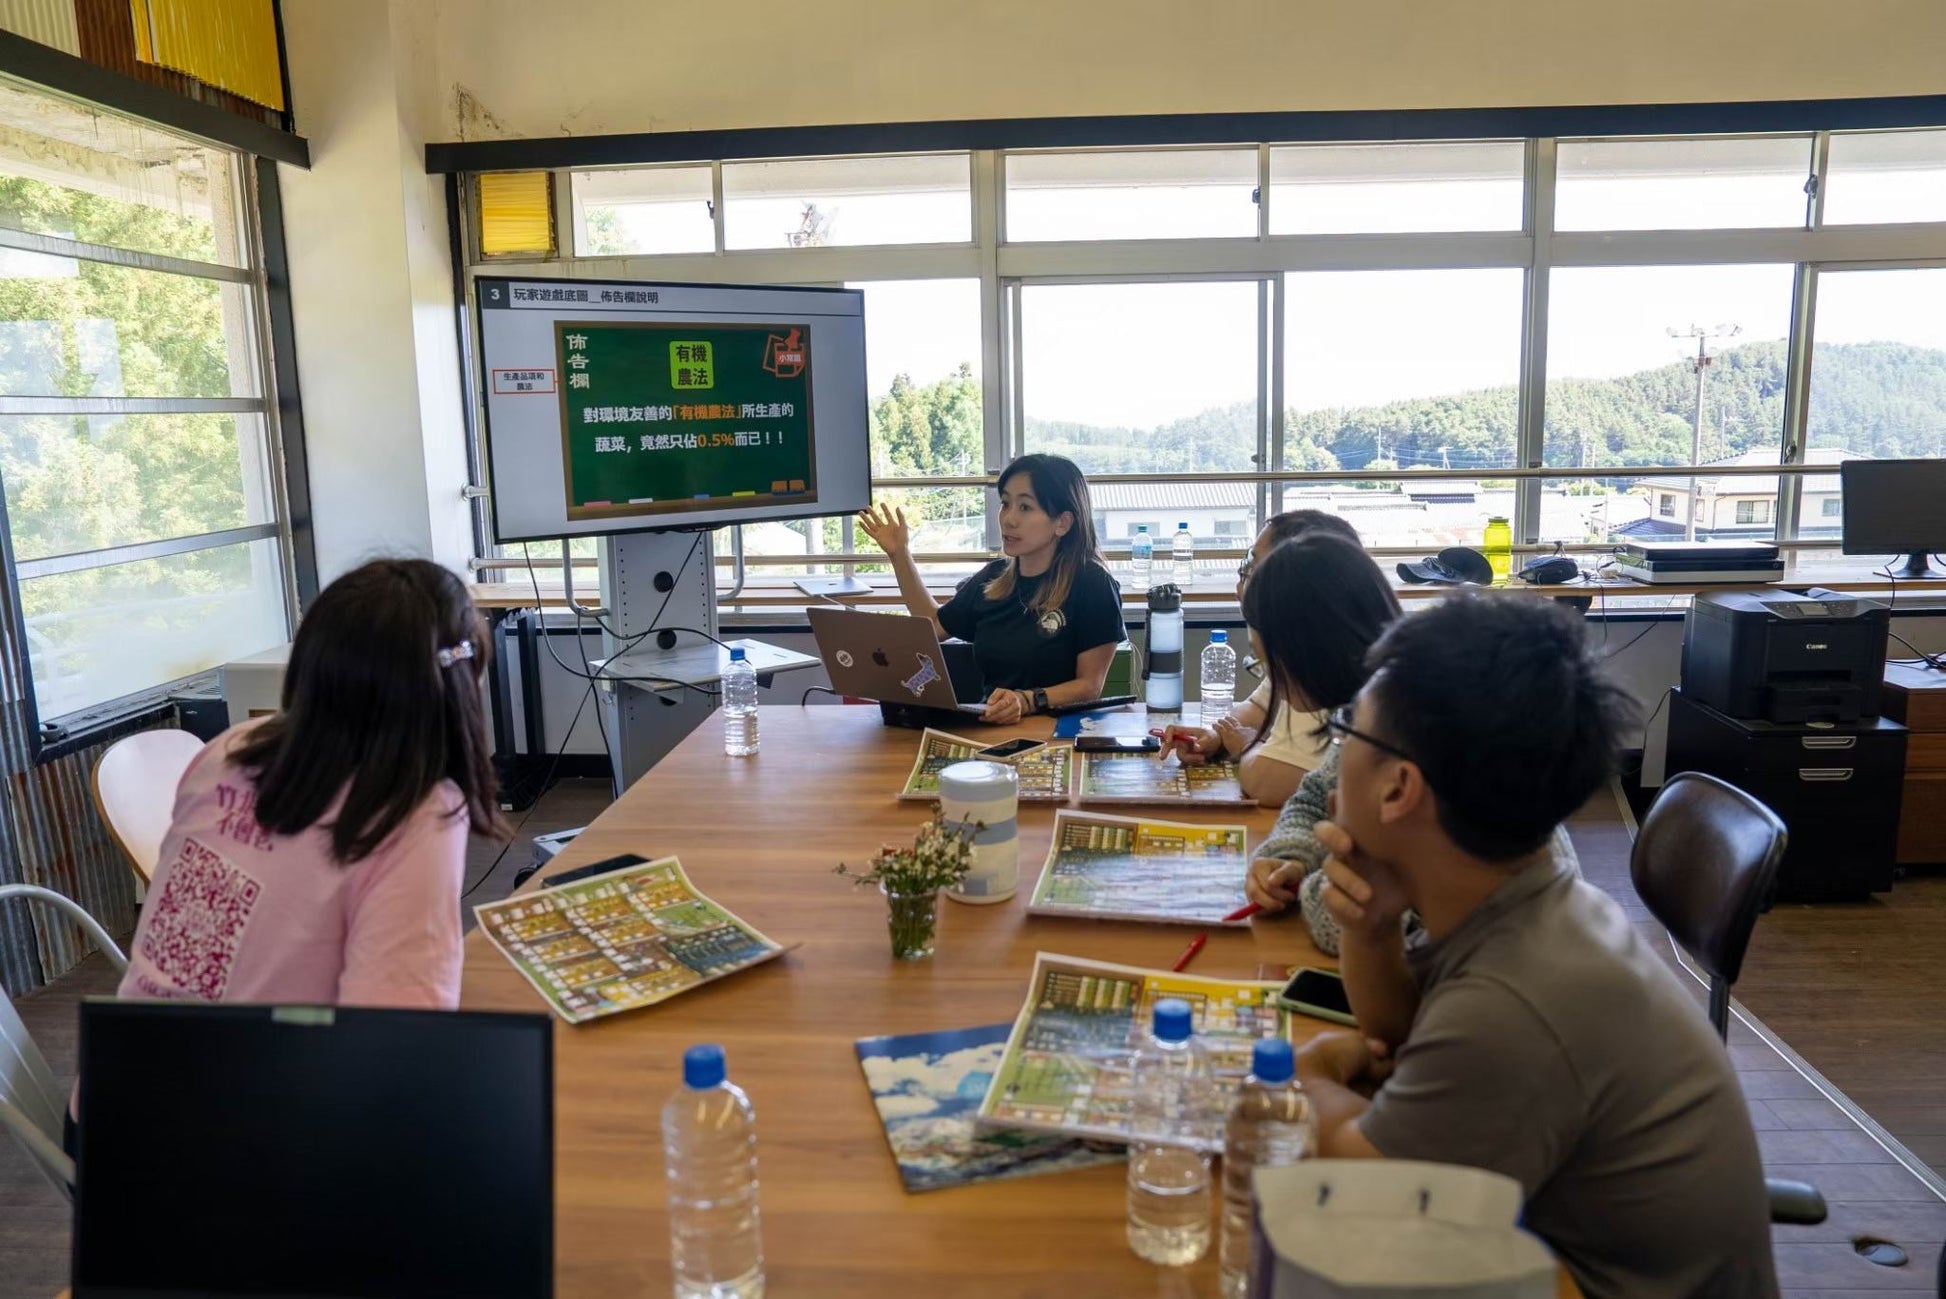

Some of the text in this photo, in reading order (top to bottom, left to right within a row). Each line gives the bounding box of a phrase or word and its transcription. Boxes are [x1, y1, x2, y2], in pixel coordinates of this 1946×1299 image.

[490, 288, 500, 300] 3
[566, 333, 590, 389] 佈告欄
[676, 344, 708, 362] 有機
[677, 367, 709, 386] 農法
